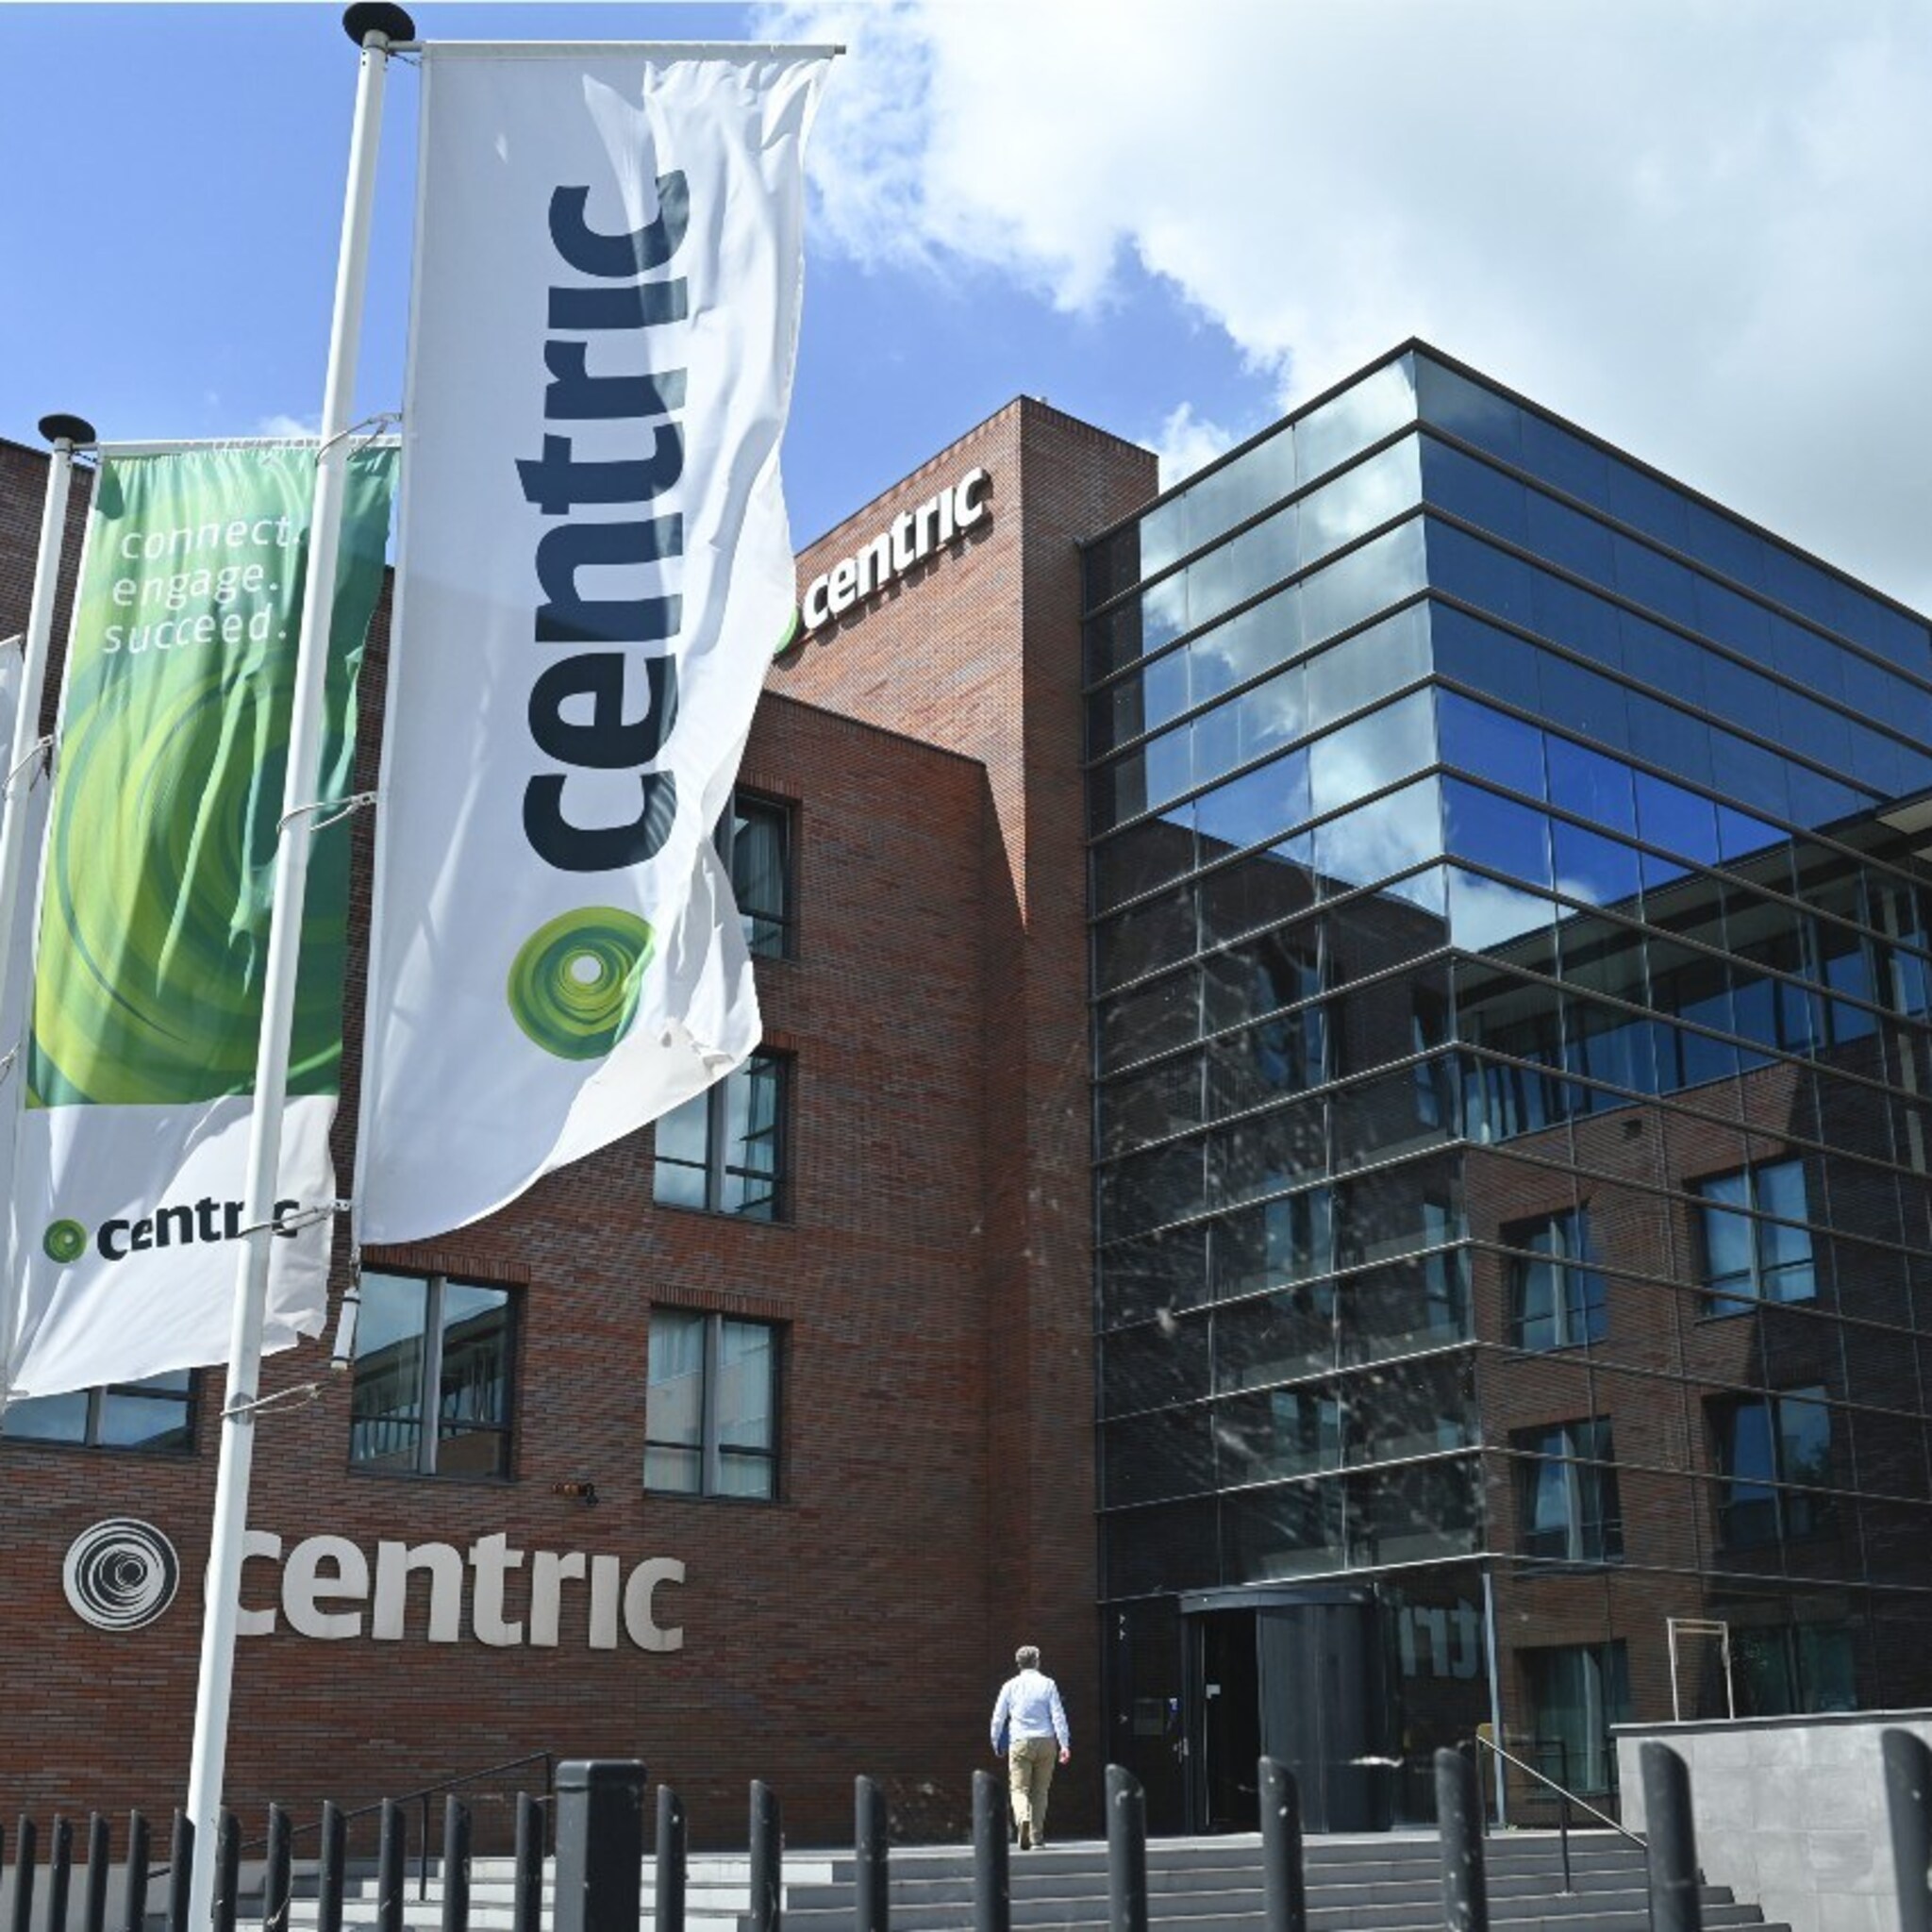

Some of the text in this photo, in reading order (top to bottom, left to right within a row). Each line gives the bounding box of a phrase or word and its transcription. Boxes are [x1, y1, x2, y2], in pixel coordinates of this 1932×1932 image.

[121, 515, 300, 559] connect.
[514, 170, 691, 872] centric
[804, 467, 984, 630] centric
[112, 562, 278, 610] engage.
[103, 603, 286, 655] succeed.
[97, 1196, 300, 1261] centrc
